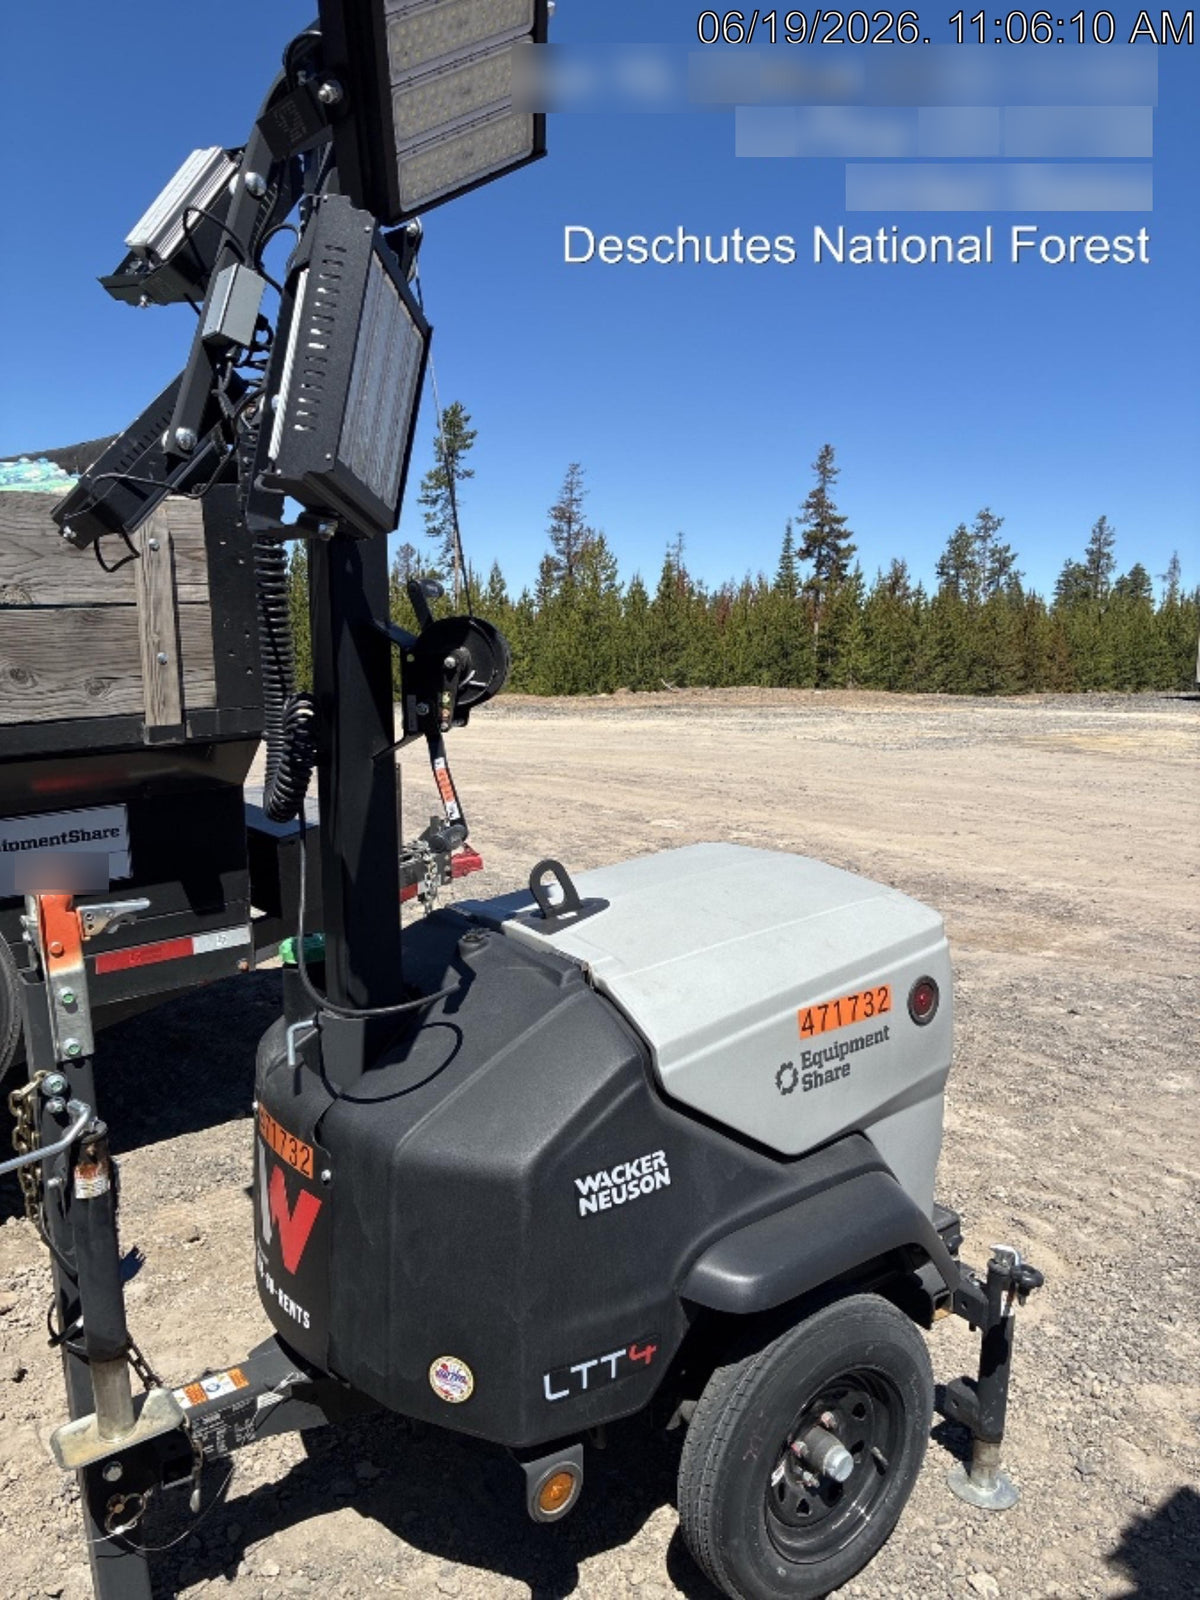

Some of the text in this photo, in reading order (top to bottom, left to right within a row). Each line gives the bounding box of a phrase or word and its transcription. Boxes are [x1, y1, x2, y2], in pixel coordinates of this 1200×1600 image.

[0, 827, 120, 852] ipmentShare
[801, 986, 889, 1035] 471732
[801, 1025, 890, 1070] Equipment
[802, 1063, 851, 1092] Share
[574, 1150, 667, 1195] WACKER
[578, 1168, 671, 1217] NEUSON
